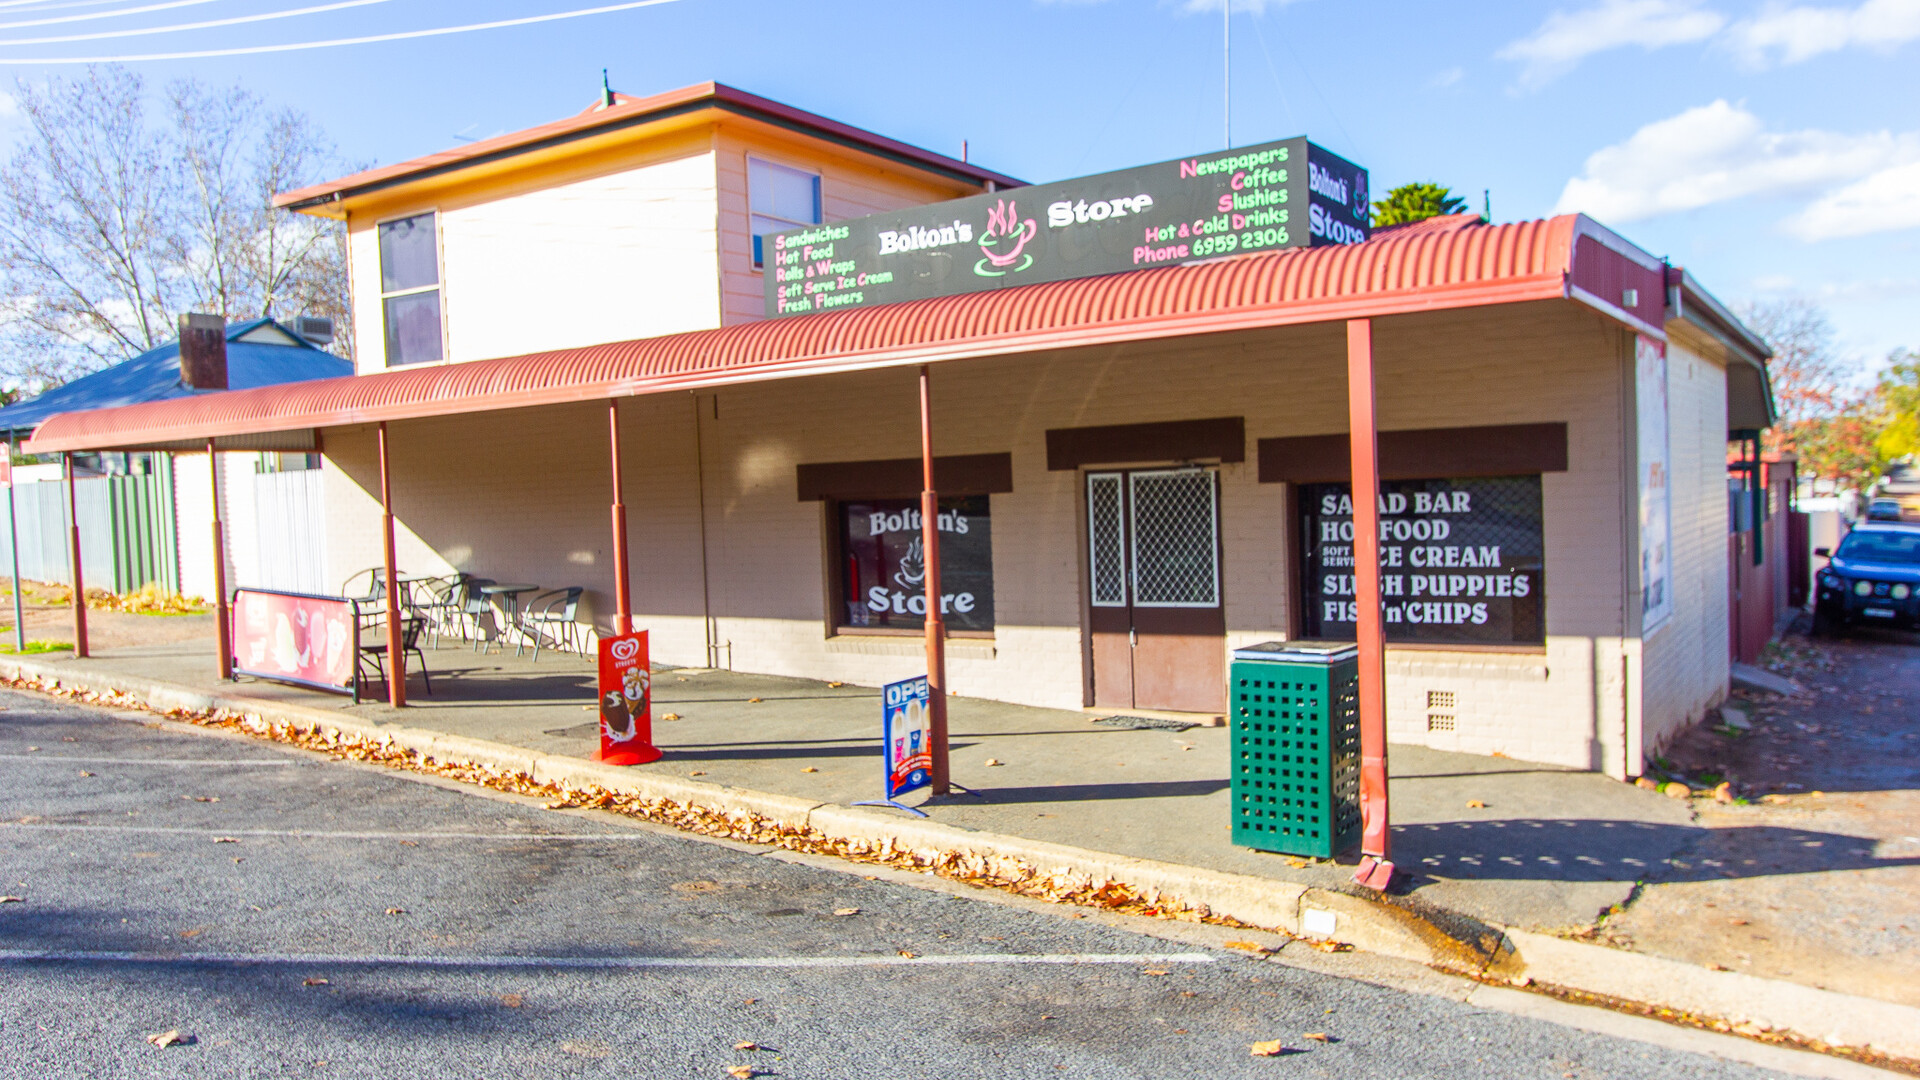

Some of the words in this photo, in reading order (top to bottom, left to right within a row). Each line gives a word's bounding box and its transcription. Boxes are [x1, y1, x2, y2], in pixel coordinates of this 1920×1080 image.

[1180, 147, 1289, 179] Newspapers
[1230, 167, 1288, 191] Coffee
[1308, 162, 1348, 206] Bolton's
[1047, 194, 1154, 228] Store
[1217, 189, 1288, 213] Slushies
[1145, 224, 1177, 243] Hot
[1178, 223, 1190, 238] &
[1192, 214, 1229, 235] Cold
[1232, 207, 1289, 230] Drinks
[1309, 202, 1365, 246] Store
[775, 225, 849, 250] Sandwiches
[878, 220, 973, 255] Bolton's
[1133, 244, 1189, 265] Phone
[1192, 233, 1238, 256] 6959
[1241, 226, 1289, 249] 2306
[775, 250, 800, 266] Hot
[803, 243, 834, 262] Food
[776, 266, 805, 282] Rolls
[805, 265, 815, 278] &
[816, 259, 856, 276] Wraps
[777, 283, 803, 299] Soft
[804, 281, 836, 294] Serve
[837, 276, 857, 290] Ice
[857, 271, 894, 287] Cream
[778, 296, 812, 314] Fresh
[815, 292, 864, 309] Flowers
[1321, 493, 1407, 515] SAAD
[1414, 491, 1471, 513] BAR
[869, 508, 969, 536] Boltn's
[1321, 520, 1355, 541] HO
[1380, 519, 1450, 541] FOOD
[1322, 546, 1351, 556] SOFT
[1409, 546, 1501, 568] CREAM
[1323, 574, 1404, 596] SLH
[1410, 575, 1530, 597] PUPPIES
[867, 586, 975, 614] Store
[1323, 601, 1358, 622] FIS
[886, 680, 928, 705] OPE
